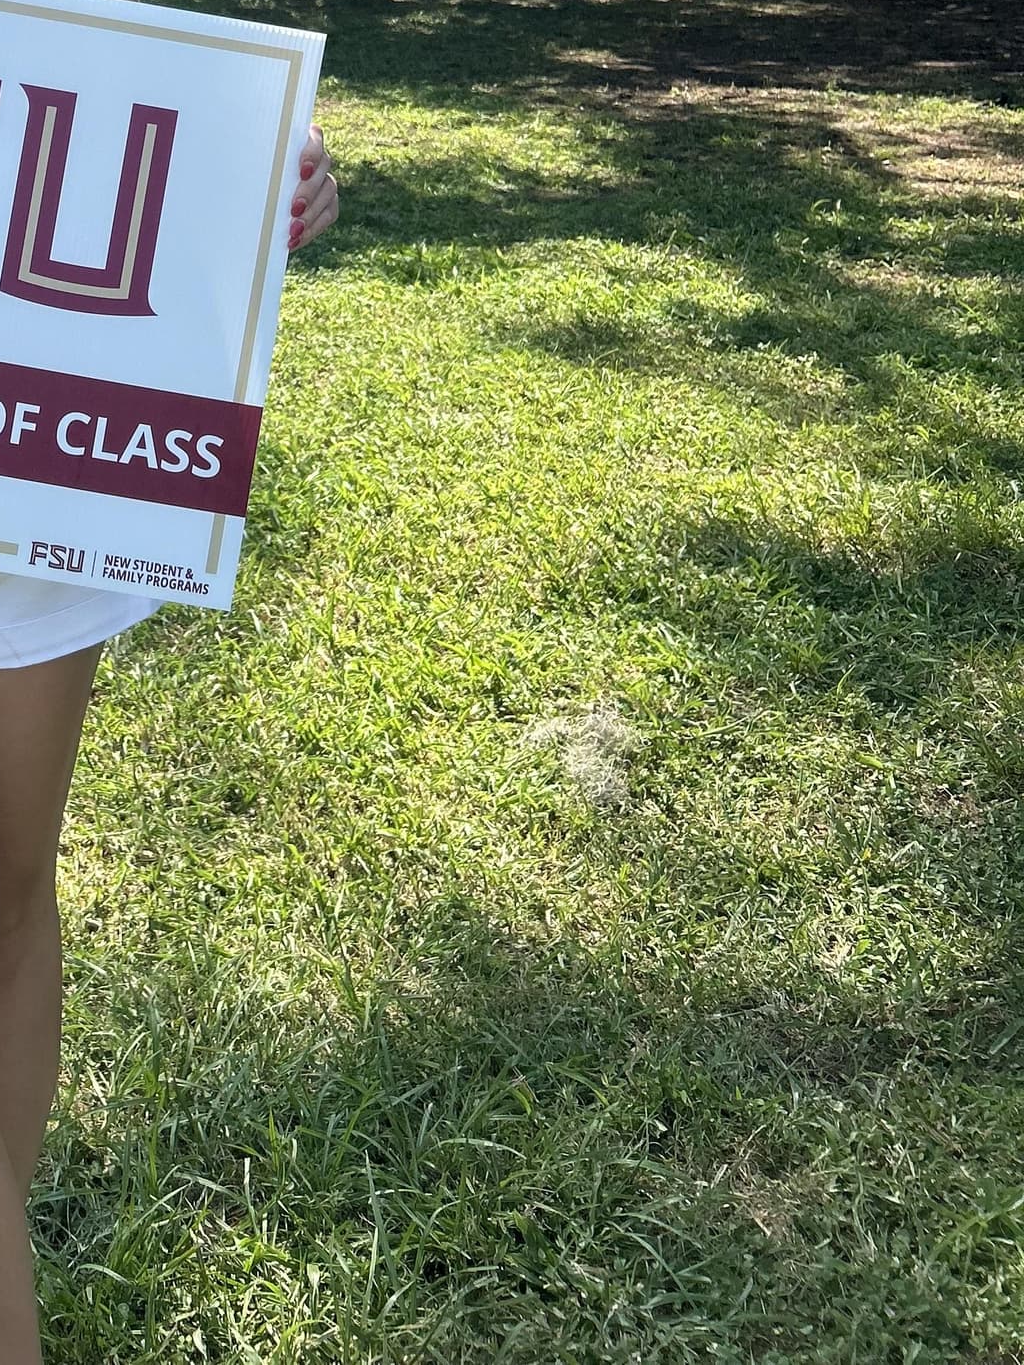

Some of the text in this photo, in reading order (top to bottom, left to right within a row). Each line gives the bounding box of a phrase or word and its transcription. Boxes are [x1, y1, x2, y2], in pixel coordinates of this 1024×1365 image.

[56, 411, 223, 478] CLASS
[28, 541, 86, 574] FSU
[104, 553, 194, 580] NEW STUDENT &
[102, 566, 210, 595] FAMILY PROGRAMS
